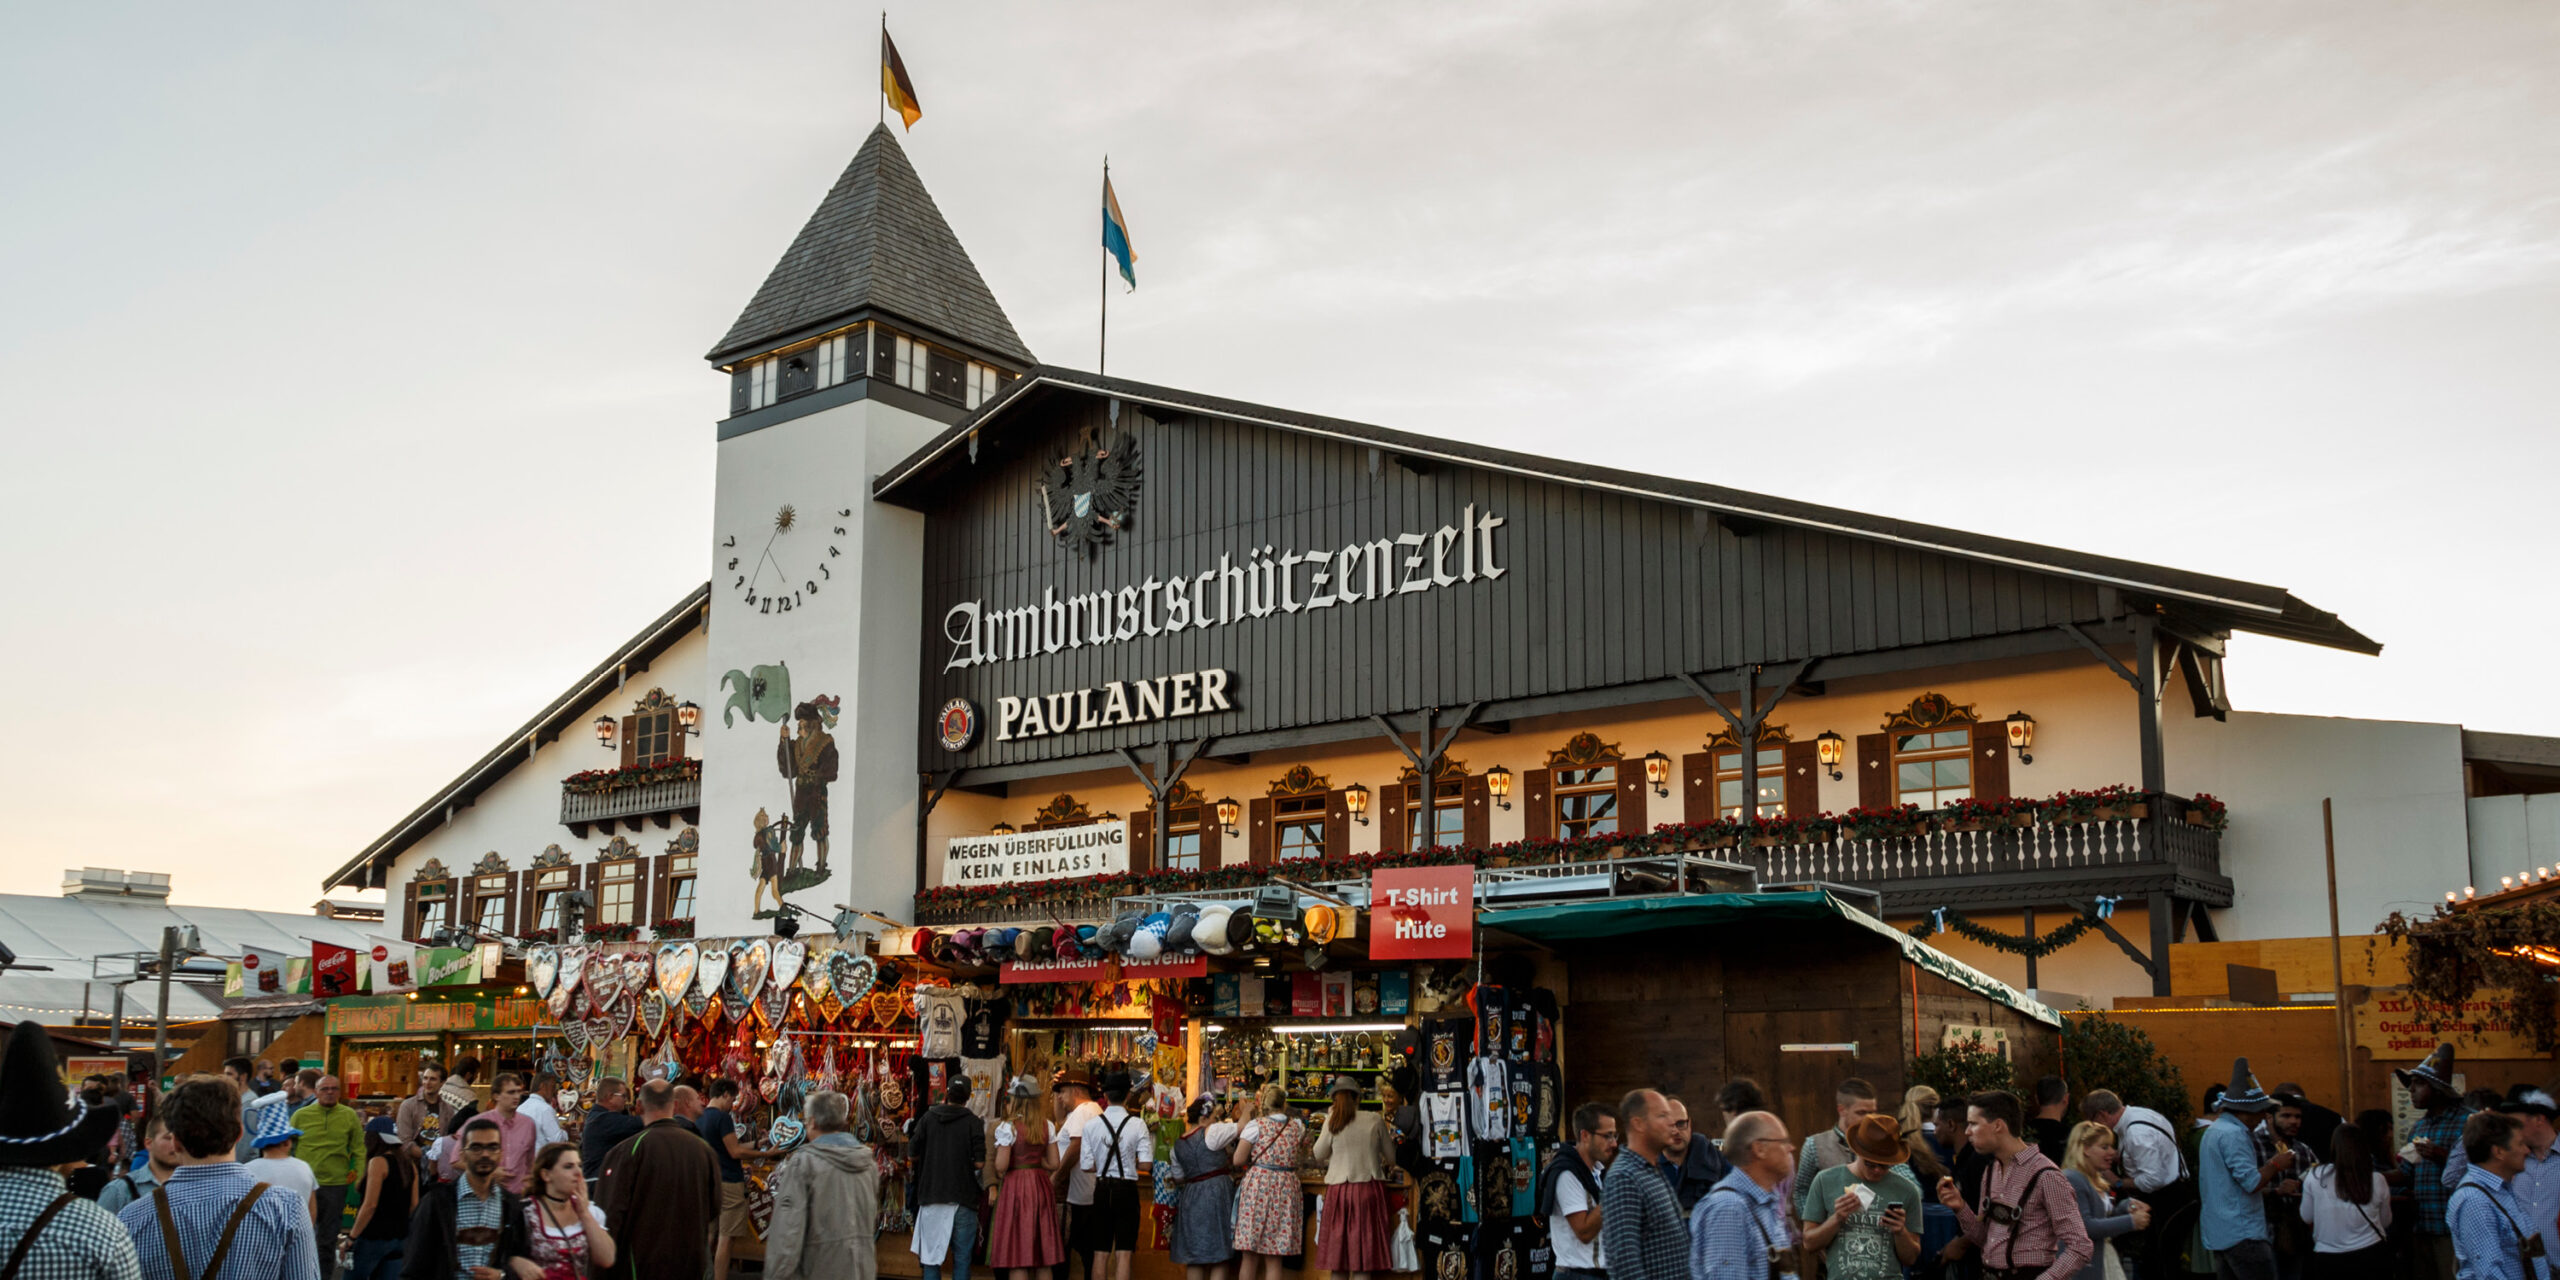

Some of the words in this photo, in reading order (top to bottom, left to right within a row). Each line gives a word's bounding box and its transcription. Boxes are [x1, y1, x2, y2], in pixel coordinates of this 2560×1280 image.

[838, 508, 851, 517] 6
[834, 526, 846, 536] 5
[828, 545, 841, 558] 4
[728, 557, 739, 570] 8
[819, 562, 830, 580] 3
[735, 575, 744, 590] 9
[806, 580, 818, 595] 2
[943, 502, 1505, 675] Armbrustschützenzelt
[744, 587, 756, 606] 10
[776, 596, 792, 613] 12
[795, 590, 801, 607] 1
[760, 597, 771, 614] 11
[996, 668, 1231, 741] PAULANER
[950, 843, 999, 860] WEGEN
[1005, 829, 1123, 856] ÜBERFÜLLUNG
[961, 863, 1004, 879] KEIN
[1013, 854, 1091, 876] EINLASS
[1101, 853, 1106, 867] !
[1386, 887, 1458, 907] T-Shirt
[1395, 920, 1447, 939] Hüte
[318, 951, 347, 971] Coca-Cola
[428, 946, 480, 985] Bockwurst
[327, 1003, 400, 1033] FEINKOST
[404, 1002, 476, 1030] LEHMAIR
[2380, 1020, 2434, 1035] Origina
[2387, 1036, 2437, 1051] spezial
